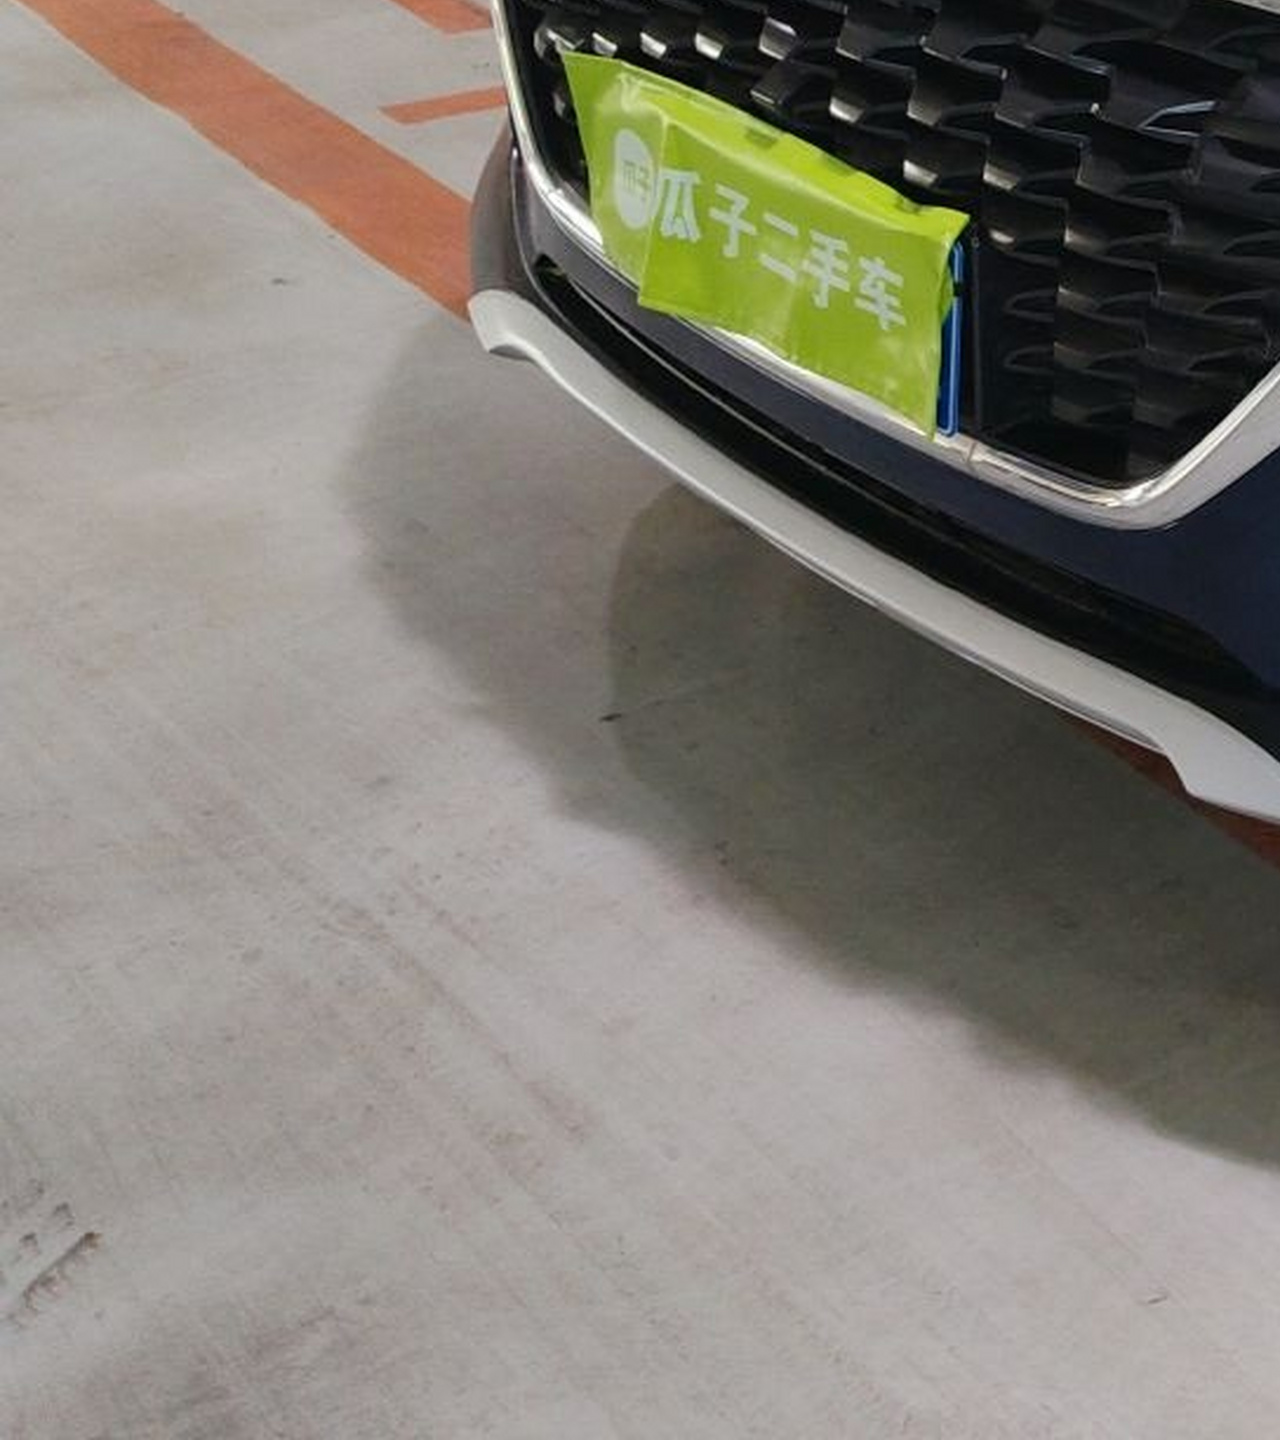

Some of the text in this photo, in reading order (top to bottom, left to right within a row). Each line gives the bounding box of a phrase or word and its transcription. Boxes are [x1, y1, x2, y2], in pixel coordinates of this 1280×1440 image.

[658, 167, 906, 331] 瓜子二手车
